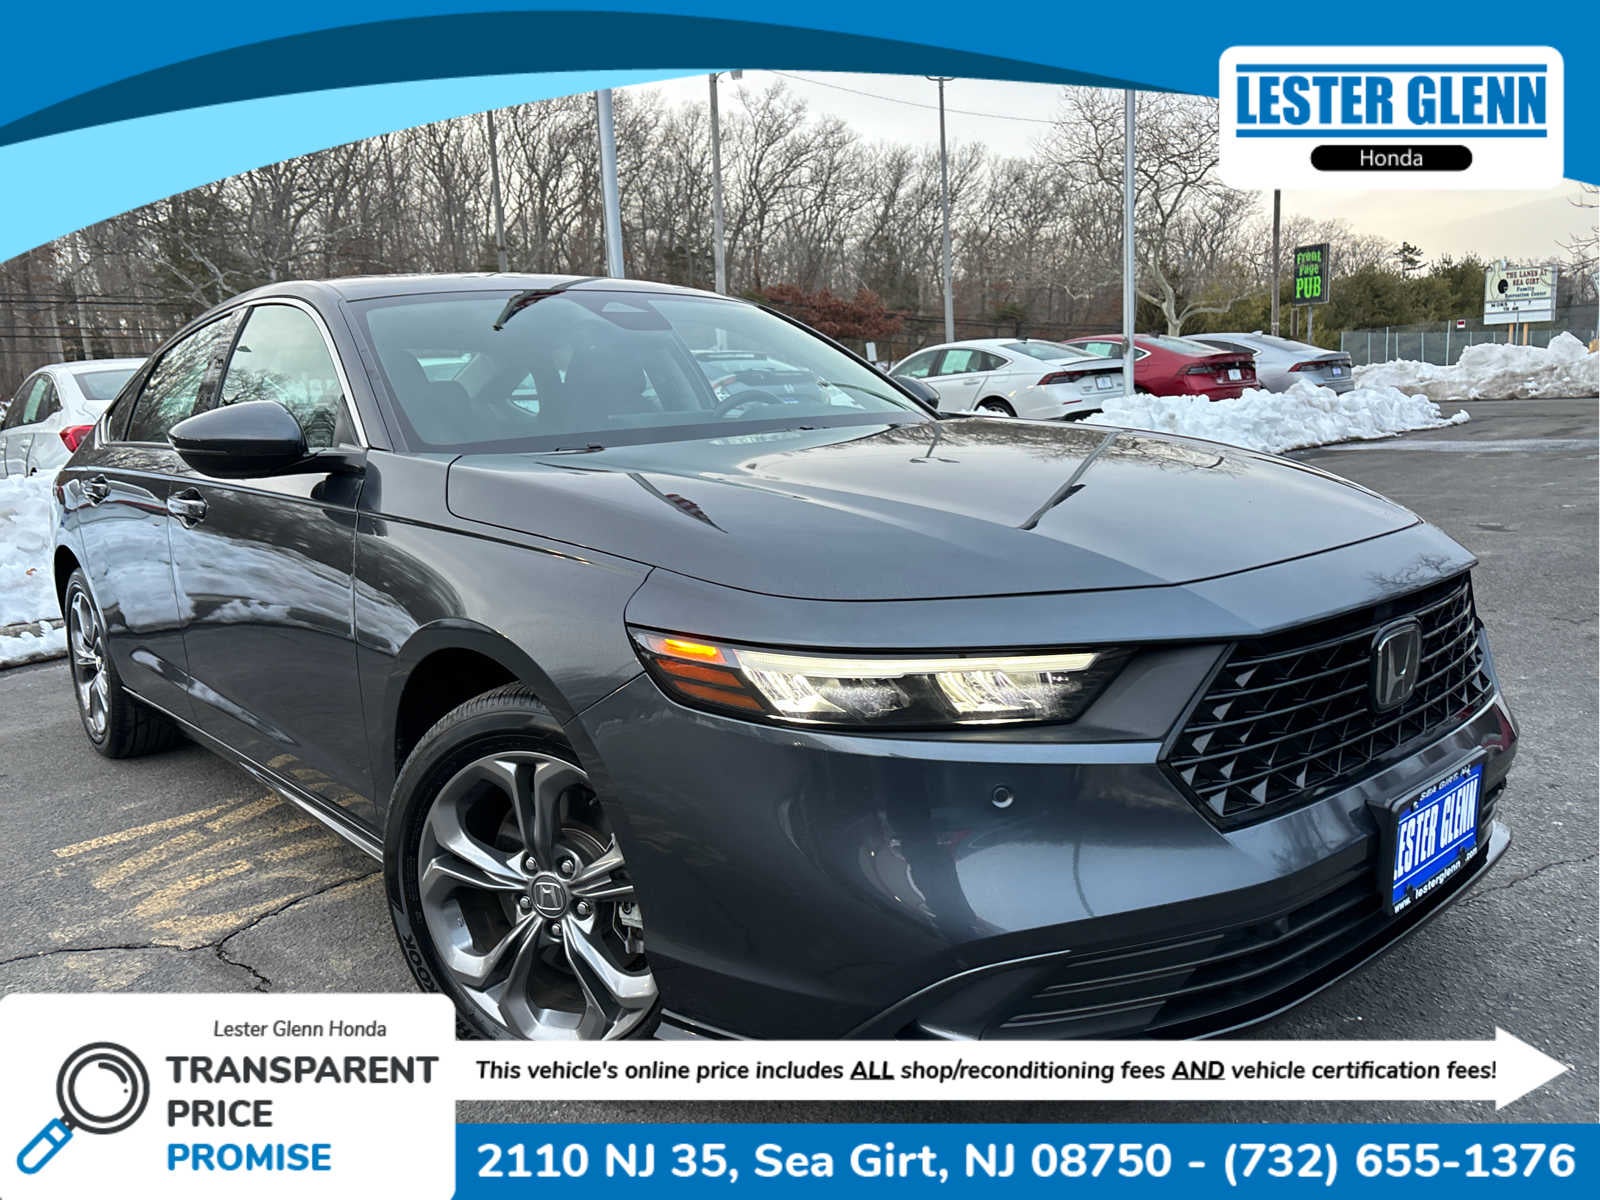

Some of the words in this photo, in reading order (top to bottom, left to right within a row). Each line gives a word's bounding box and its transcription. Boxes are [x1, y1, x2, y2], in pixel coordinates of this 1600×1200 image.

[1296, 276, 1321, 298] PUB
[1393, 804, 1439, 881] ESTER
[1440, 778, 1479, 849] GLENN
